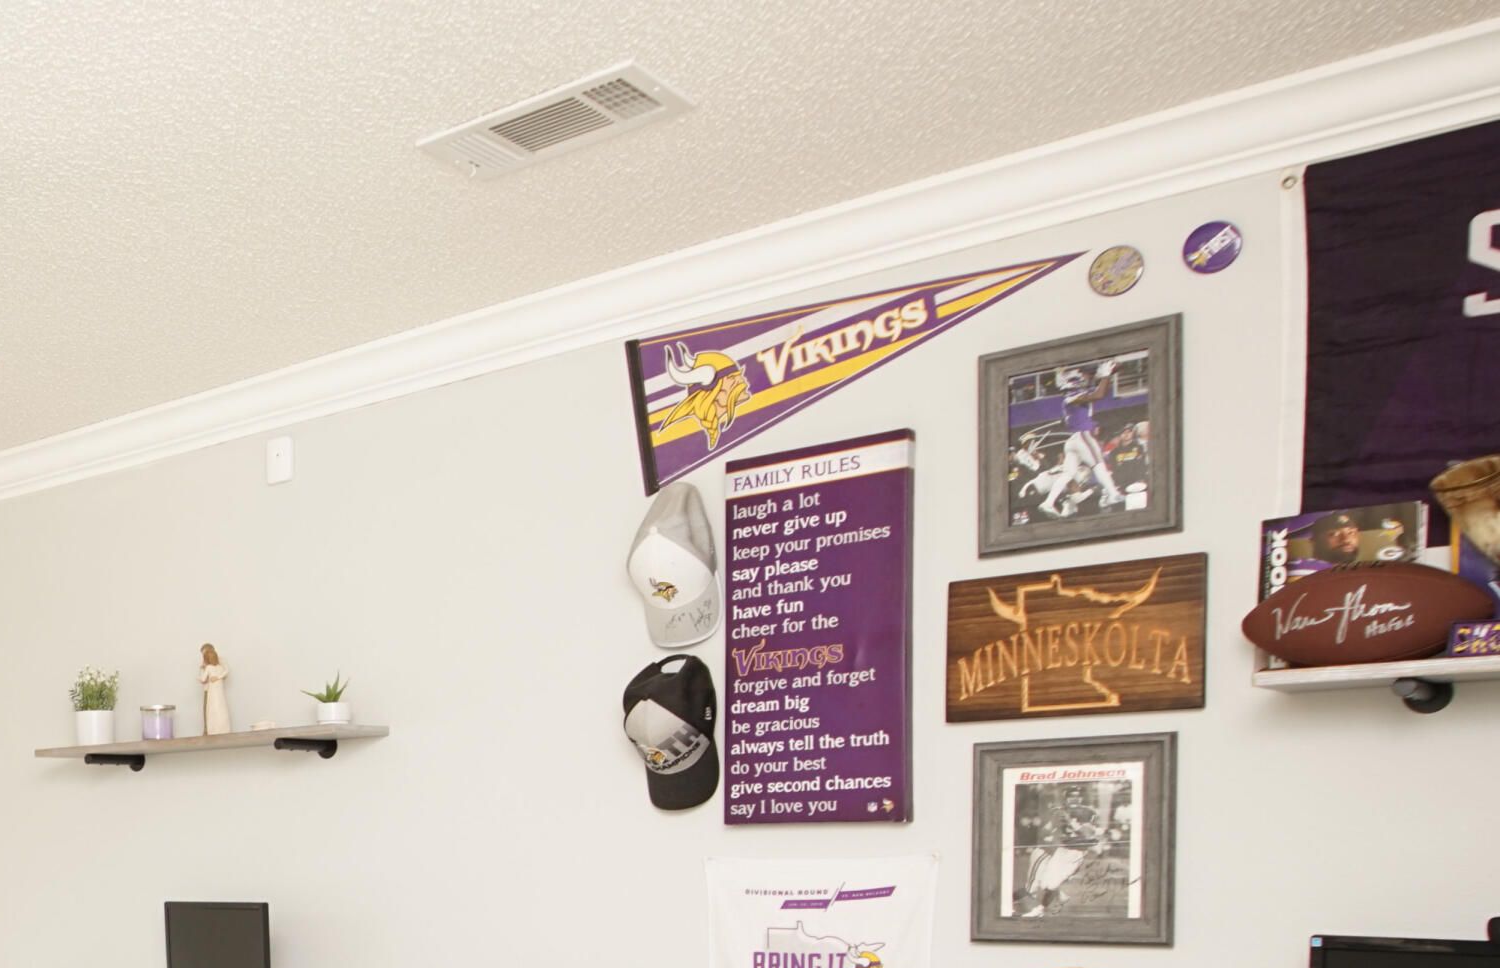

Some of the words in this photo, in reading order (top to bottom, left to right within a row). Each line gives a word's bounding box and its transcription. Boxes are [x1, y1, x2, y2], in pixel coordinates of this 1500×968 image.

[733, 467, 795, 492] FAMILY
[801, 455, 861, 480] RULES
[733, 499, 777, 520] laugh
[782, 499, 793, 512] a
[799, 492, 821, 509] lot
[732, 521, 779, 540] never
[783, 513, 820, 535] give
[825, 510, 847, 527] up
[733, 543, 770, 561] keep
[775, 537, 811, 557] your
[815, 525, 891, 552] promises
[732, 566, 759, 582] say
[764, 557, 819, 580] please
[732, 583, 762, 601] and
[767, 576, 814, 595] thank
[820, 572, 852, 593] you
[733, 602, 772, 620] have
[776, 598, 804, 614] fun
[732, 621, 776, 639] cheer
[782, 617, 806, 634] for
[811, 613, 839, 629] the
[957, 621, 1192, 701] MINNESKOLTA
[733, 676, 787, 696] forgive
[792, 672, 821, 689] and
[826, 668, 876, 687] forget
[731, 698, 780, 714] dream
[784, 695, 810, 713] big
[732, 720, 750, 735] be
[755, 716, 820, 737] gracious
[731, 738, 784, 756] always
[789, 734, 814, 751] tell
[819, 733, 845, 749] the
[850, 730, 890, 746] truth
[731, 759, 750, 775] do
[754, 760, 789, 777] your
[793, 756, 827, 771] best
[1019, 769, 1056, 782] Brad
[1060, 768, 1126, 781] Johnson
[731, 781, 763, 798] give
[767, 776, 820, 794] second
[825, 775, 892, 791] chances
[731, 802, 756, 818] say
[760, 800, 766, 814] I
[770, 798, 803, 813] love
[808, 799, 838, 816] you
[745, 888, 794, 896] DIVISIONAL
[797, 888, 828, 896] ROUND
